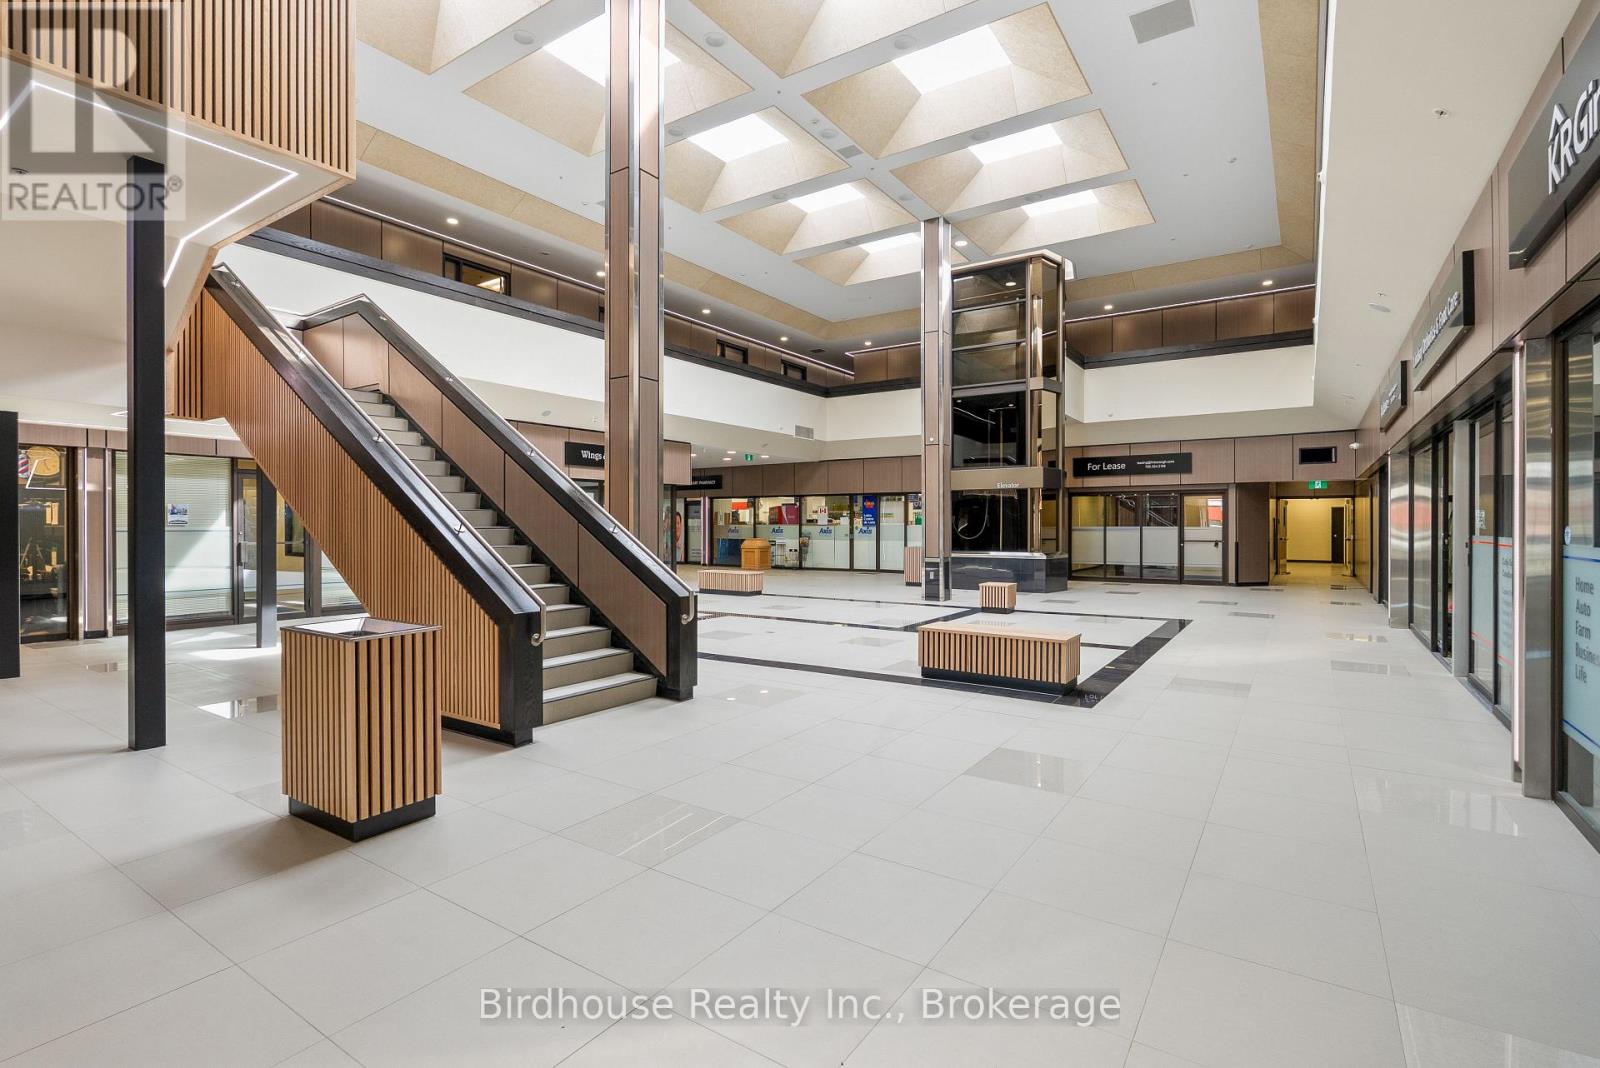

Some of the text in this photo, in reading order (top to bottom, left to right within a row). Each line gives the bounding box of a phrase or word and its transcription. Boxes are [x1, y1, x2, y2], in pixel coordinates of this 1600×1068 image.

[1448, 291, 1460, 316] Care
[581, 449, 602, 461] Wings
[1087, 462, 1101, 471] For
[1102, 461, 1126, 471] Lease
[771, 526, 784, 535] Axis
[819, 526, 833, 535] Axis
[858, 526, 873, 535] Axis
[1575, 577, 1594, 595] Home
[1575, 600, 1591, 617] Auto
[1575, 620, 1591, 641] Farm
[1575, 664, 1588, 684] Life
